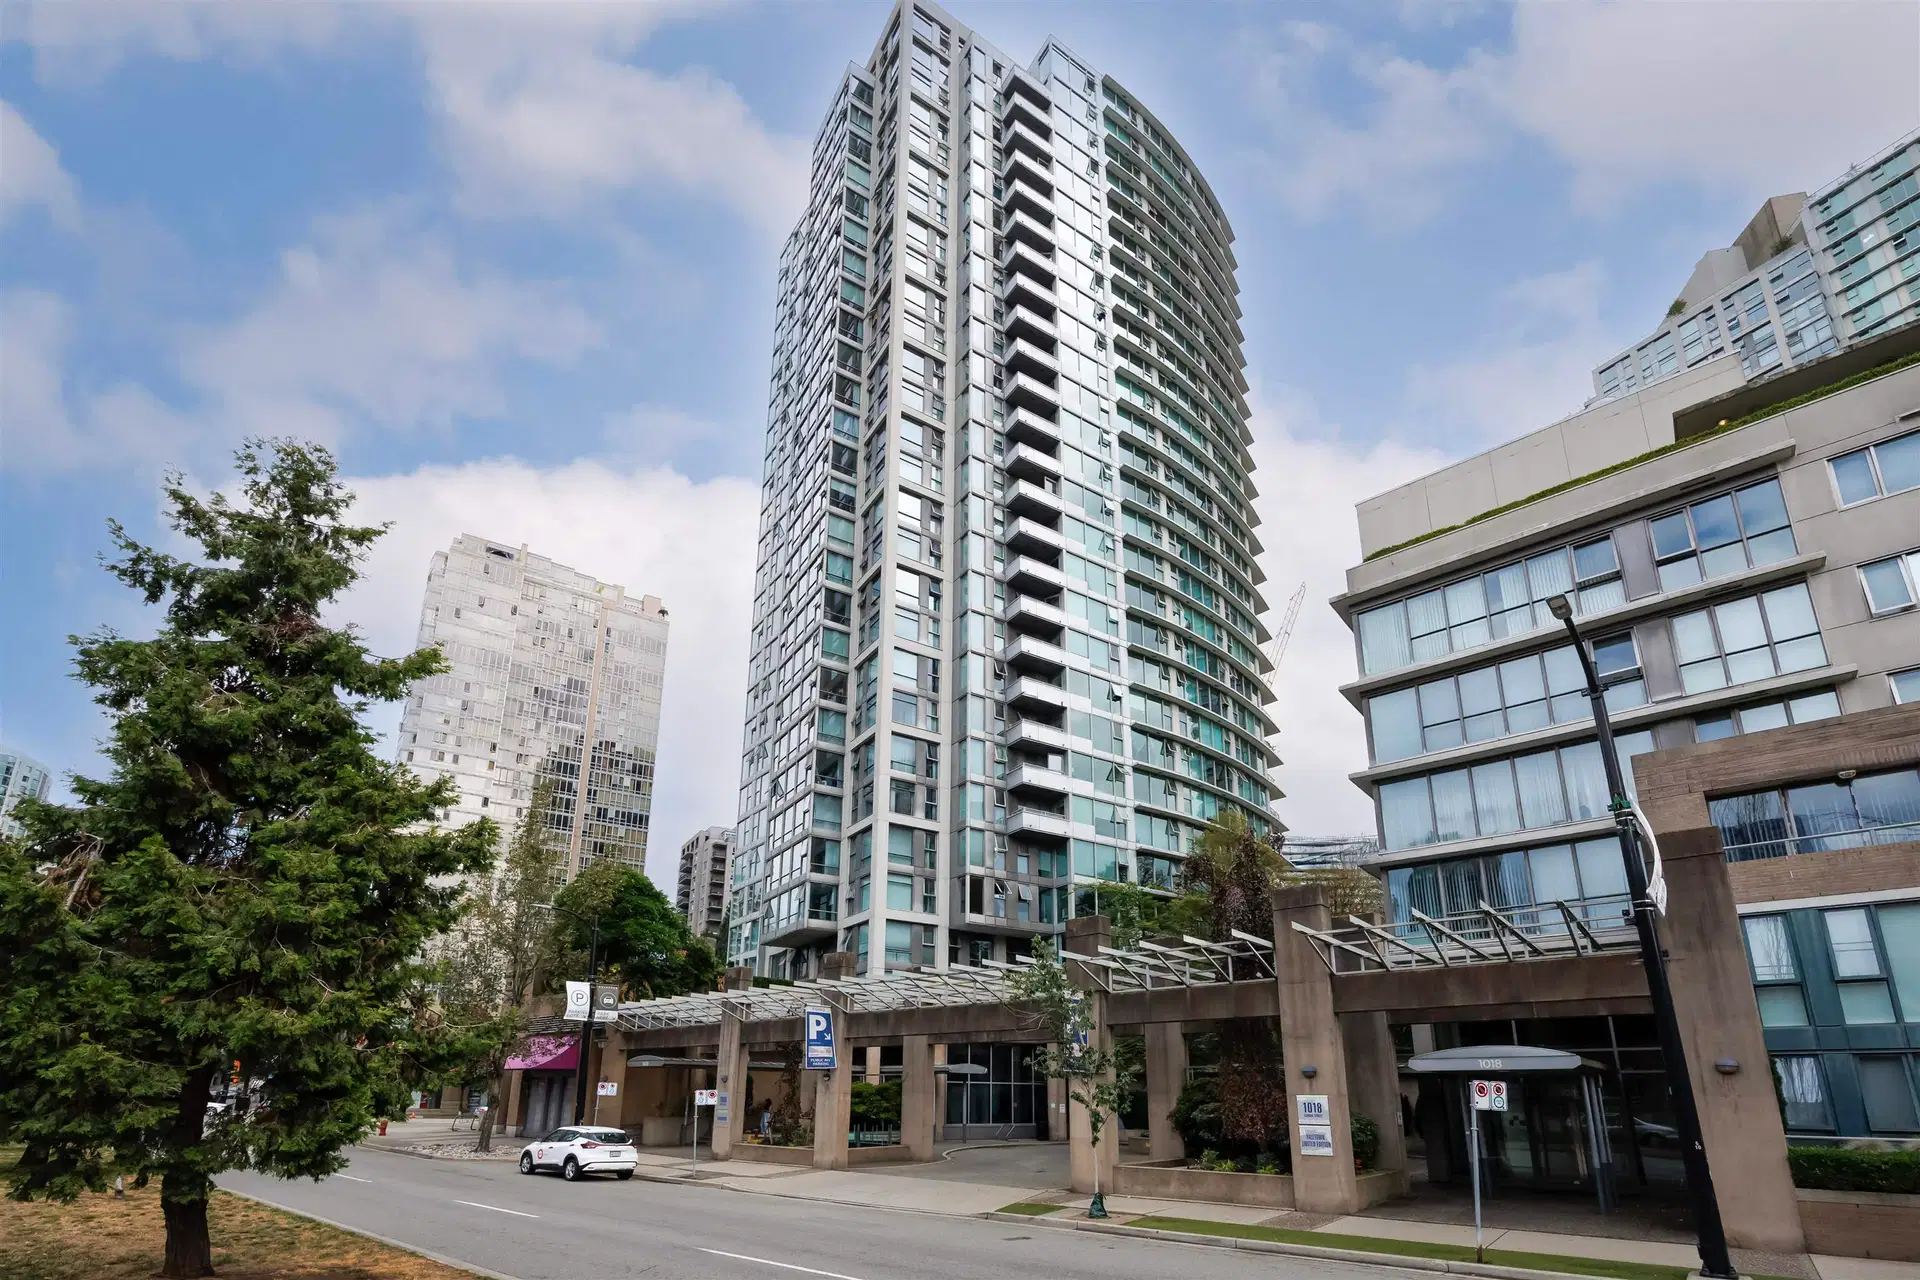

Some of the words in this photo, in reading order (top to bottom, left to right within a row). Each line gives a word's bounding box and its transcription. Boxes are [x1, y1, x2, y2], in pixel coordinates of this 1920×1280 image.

[576, 992, 584, 1003] P
[809, 1014, 827, 1040] P
[1478, 1059, 1503, 1069] 1018
[1303, 1102, 1323, 1113] 1018
